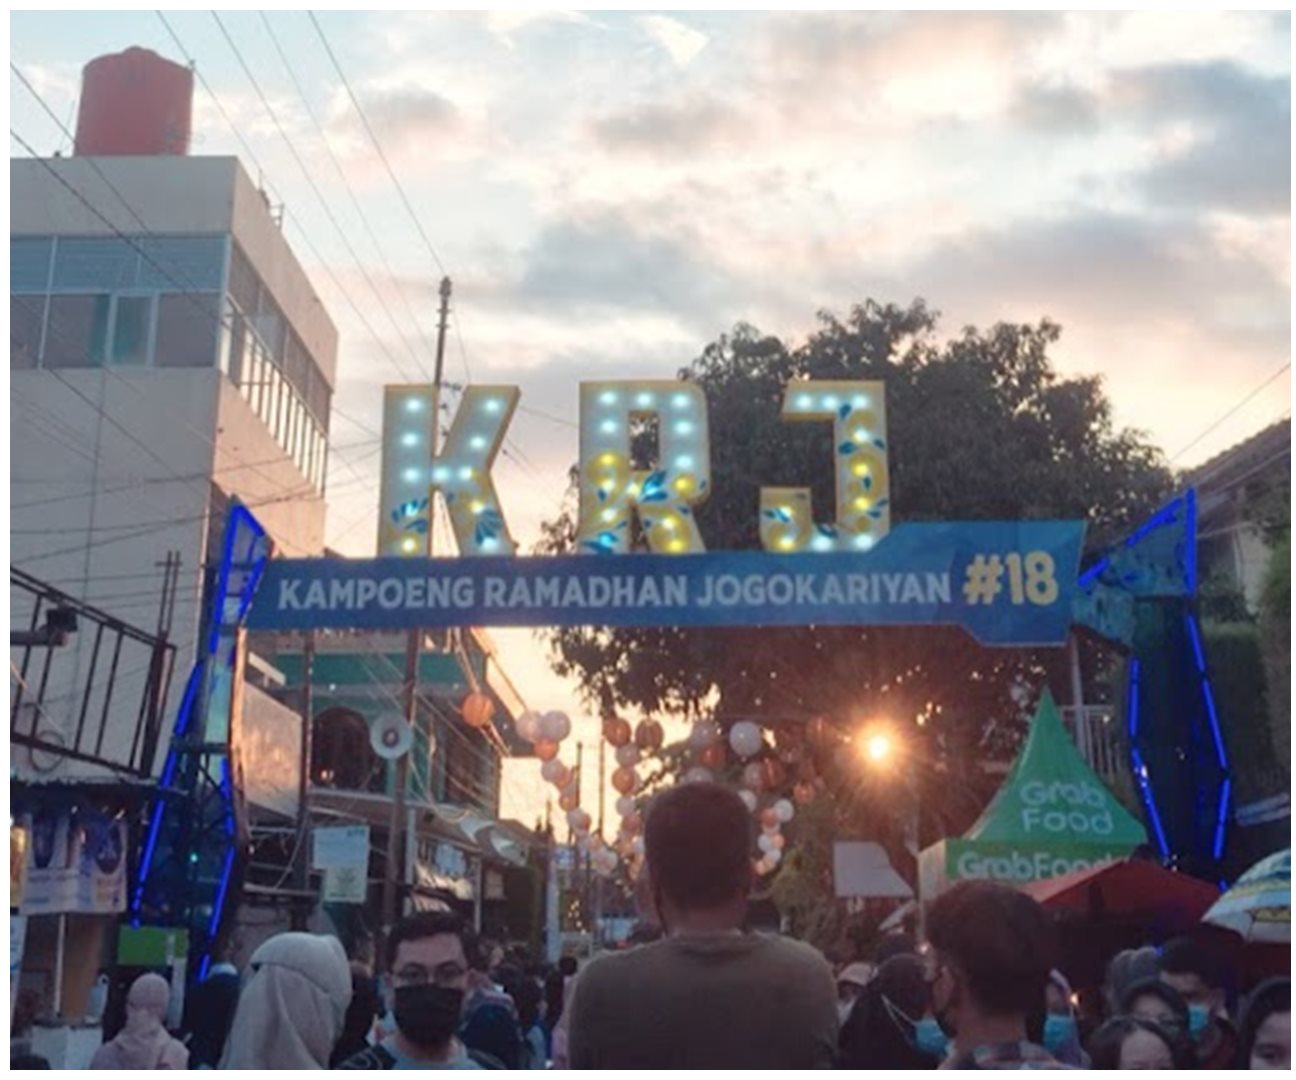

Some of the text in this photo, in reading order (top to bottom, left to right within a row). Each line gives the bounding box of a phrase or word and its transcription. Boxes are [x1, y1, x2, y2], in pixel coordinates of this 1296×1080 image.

[377, 380, 889, 555] KRJ
[277, 551, 1059, 610] KAMPOENG RAMADHAN JOGOKARIYAN #18
[1020, 780, 1106, 809] Grab
[1021, 809, 1115, 835] Food
